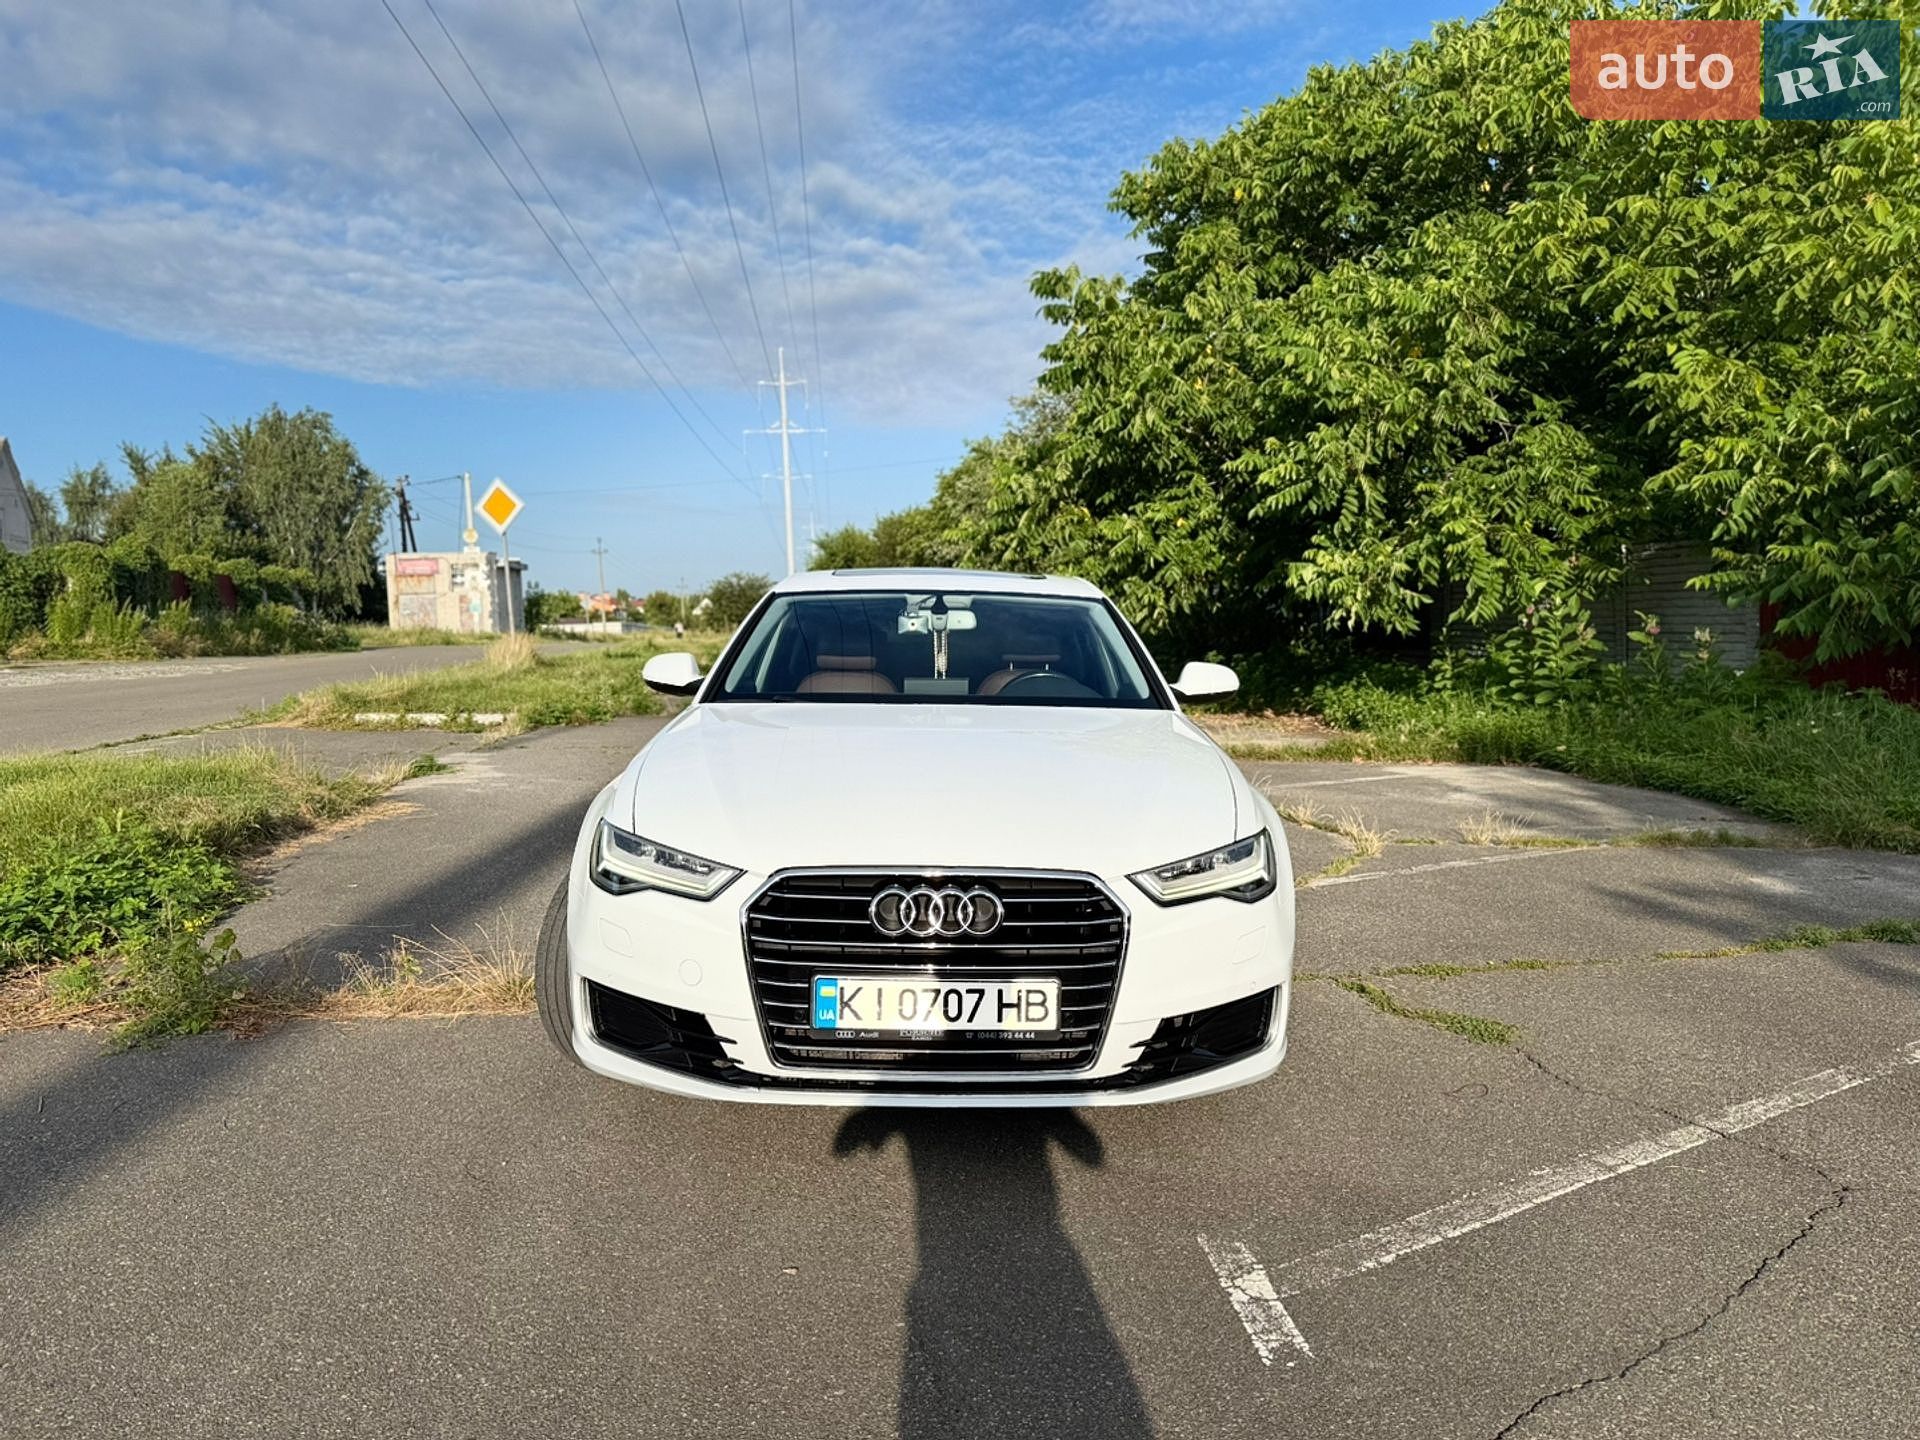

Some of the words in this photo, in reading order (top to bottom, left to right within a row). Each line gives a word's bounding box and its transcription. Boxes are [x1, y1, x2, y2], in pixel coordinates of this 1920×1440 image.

[898, 988, 986, 1023] 0707
[997, 989, 1050, 1023] HB
[819, 1009, 835, 1020] UA
[859, 1031, 879, 1039] Audi
